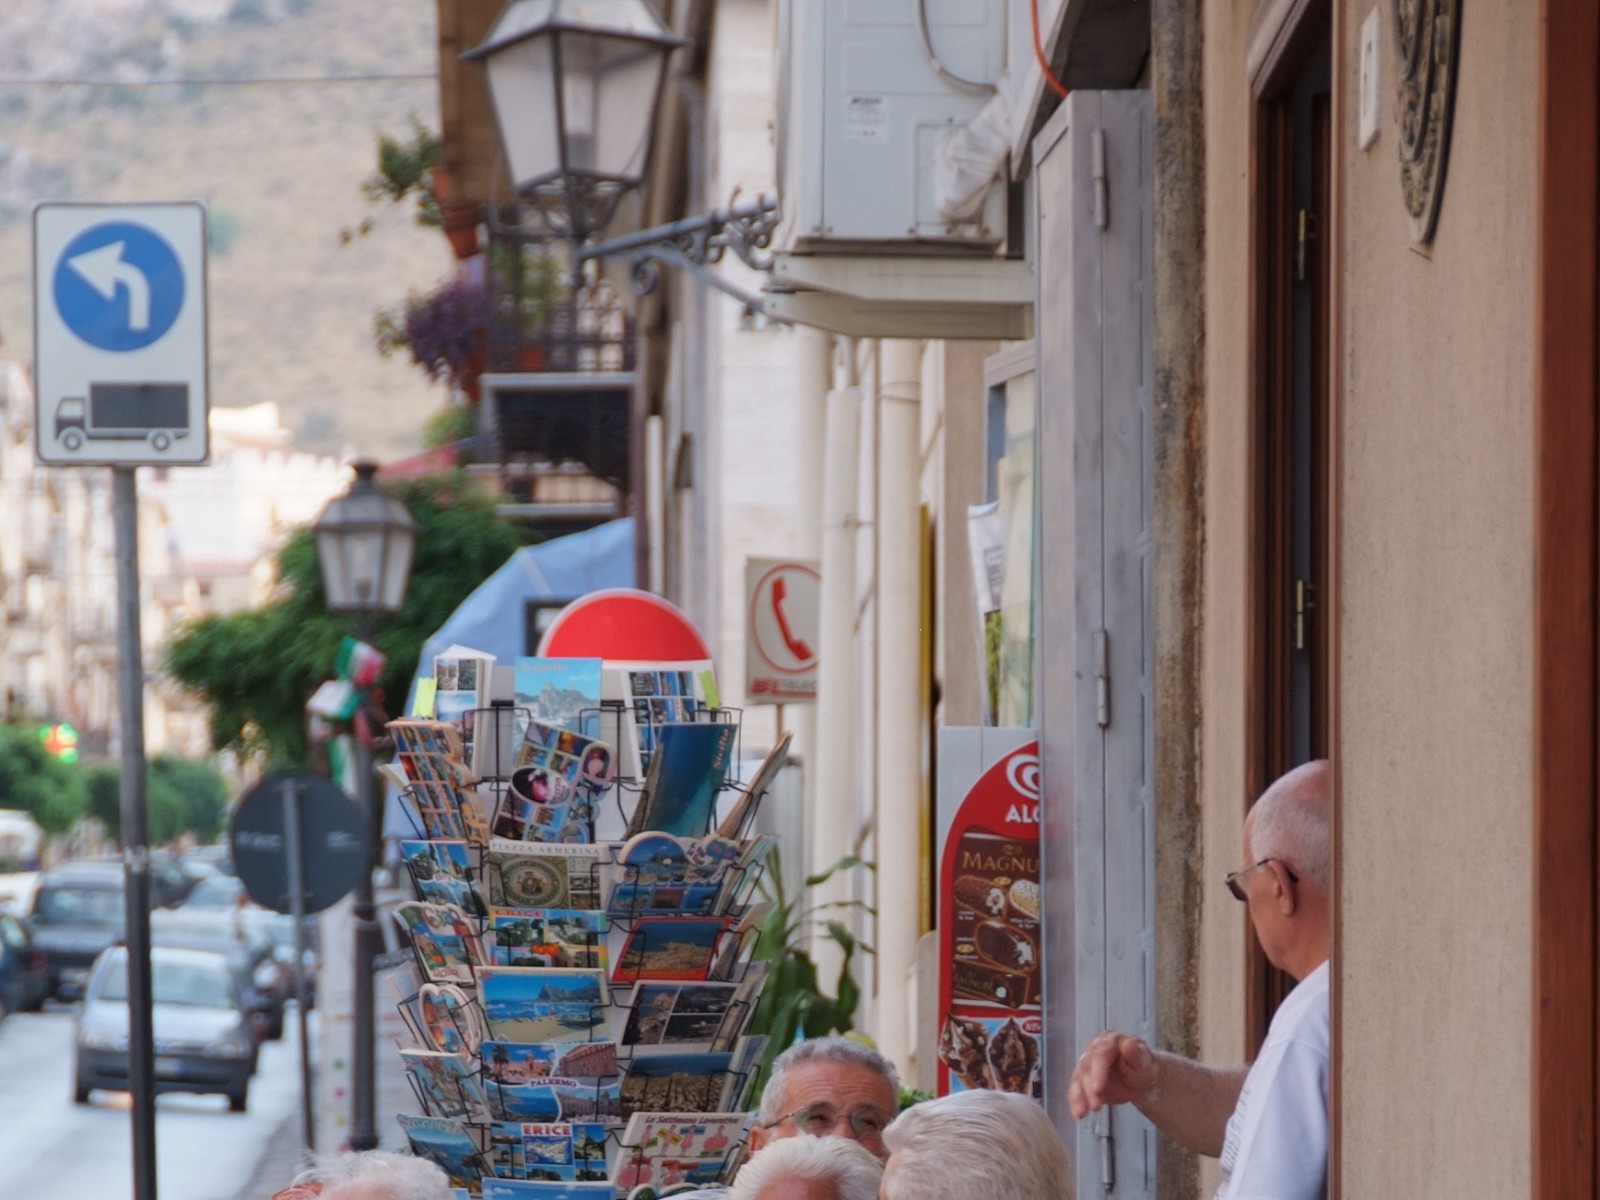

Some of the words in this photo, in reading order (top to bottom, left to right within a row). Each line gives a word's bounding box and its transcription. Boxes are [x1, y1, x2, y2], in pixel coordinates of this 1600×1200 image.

[492, 843, 534, 852] PIAZZA
[540, 844, 600, 855] ARMERINA
[963, 851, 1039, 873] MAGNU
[530, 1078, 577, 1088] PALERMO
[523, 1125, 571, 1136] ERICE
